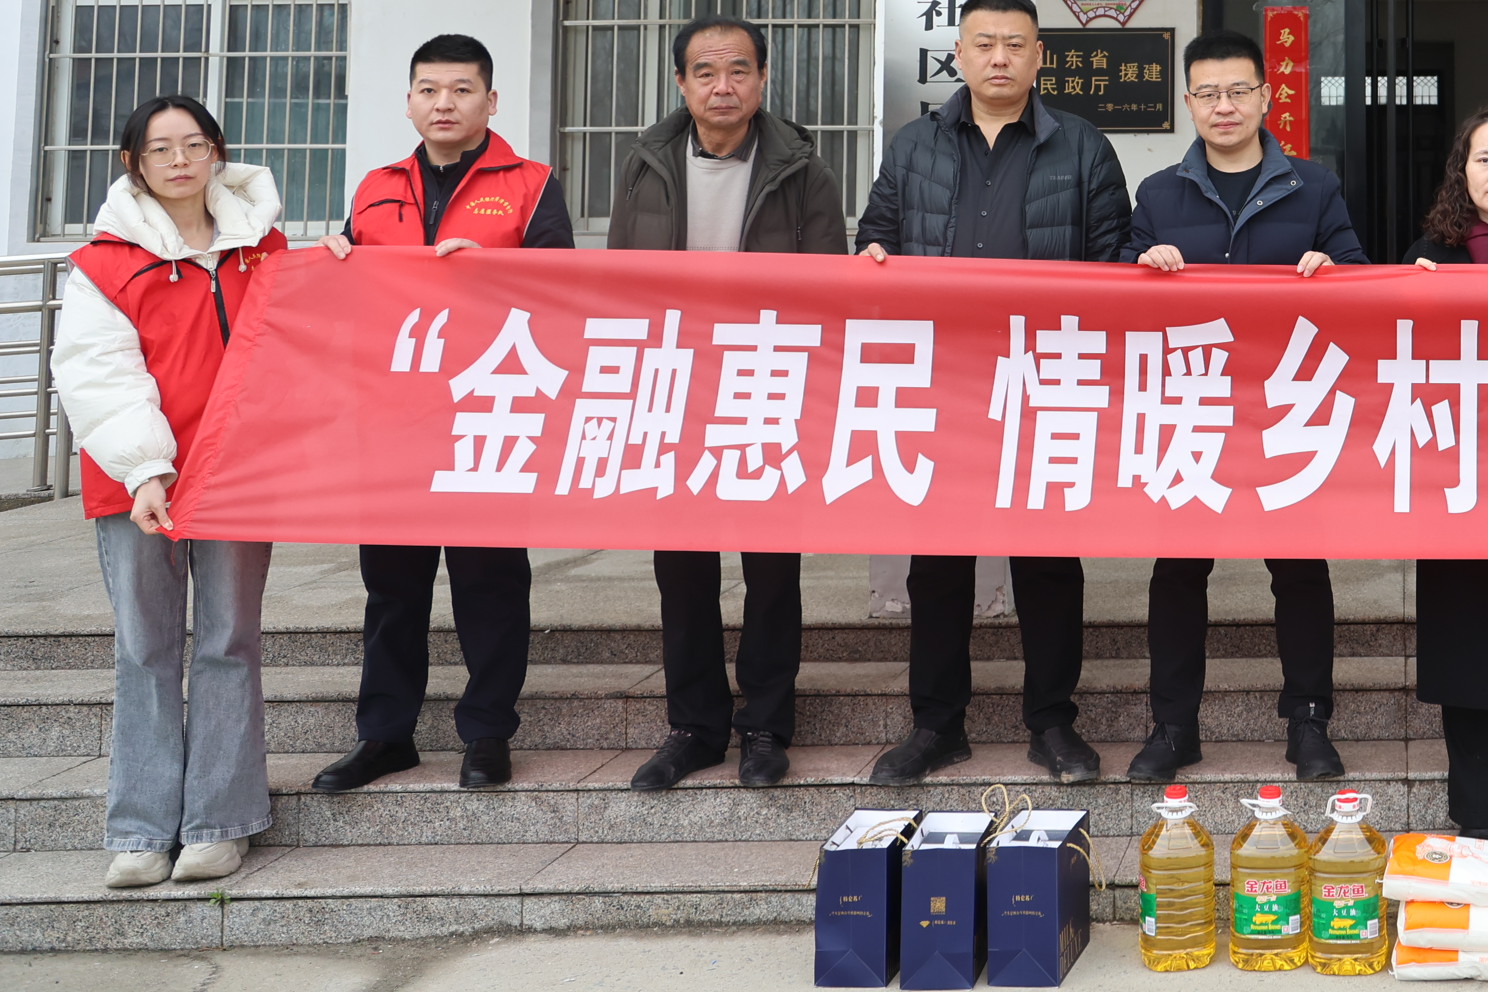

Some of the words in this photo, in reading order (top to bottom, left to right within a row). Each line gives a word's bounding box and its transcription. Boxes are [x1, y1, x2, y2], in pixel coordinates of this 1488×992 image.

[1041, 49, 1109, 69] 山东省
[1119, 62, 1162, 82] 援建
[1039, 76, 1109, 95] 民政厅
[390, 307, 937, 507] “金融惠民
[1245, 879, 1289, 894] 金龙鱼
[1322, 883, 1366, 899] 金龙鱼
